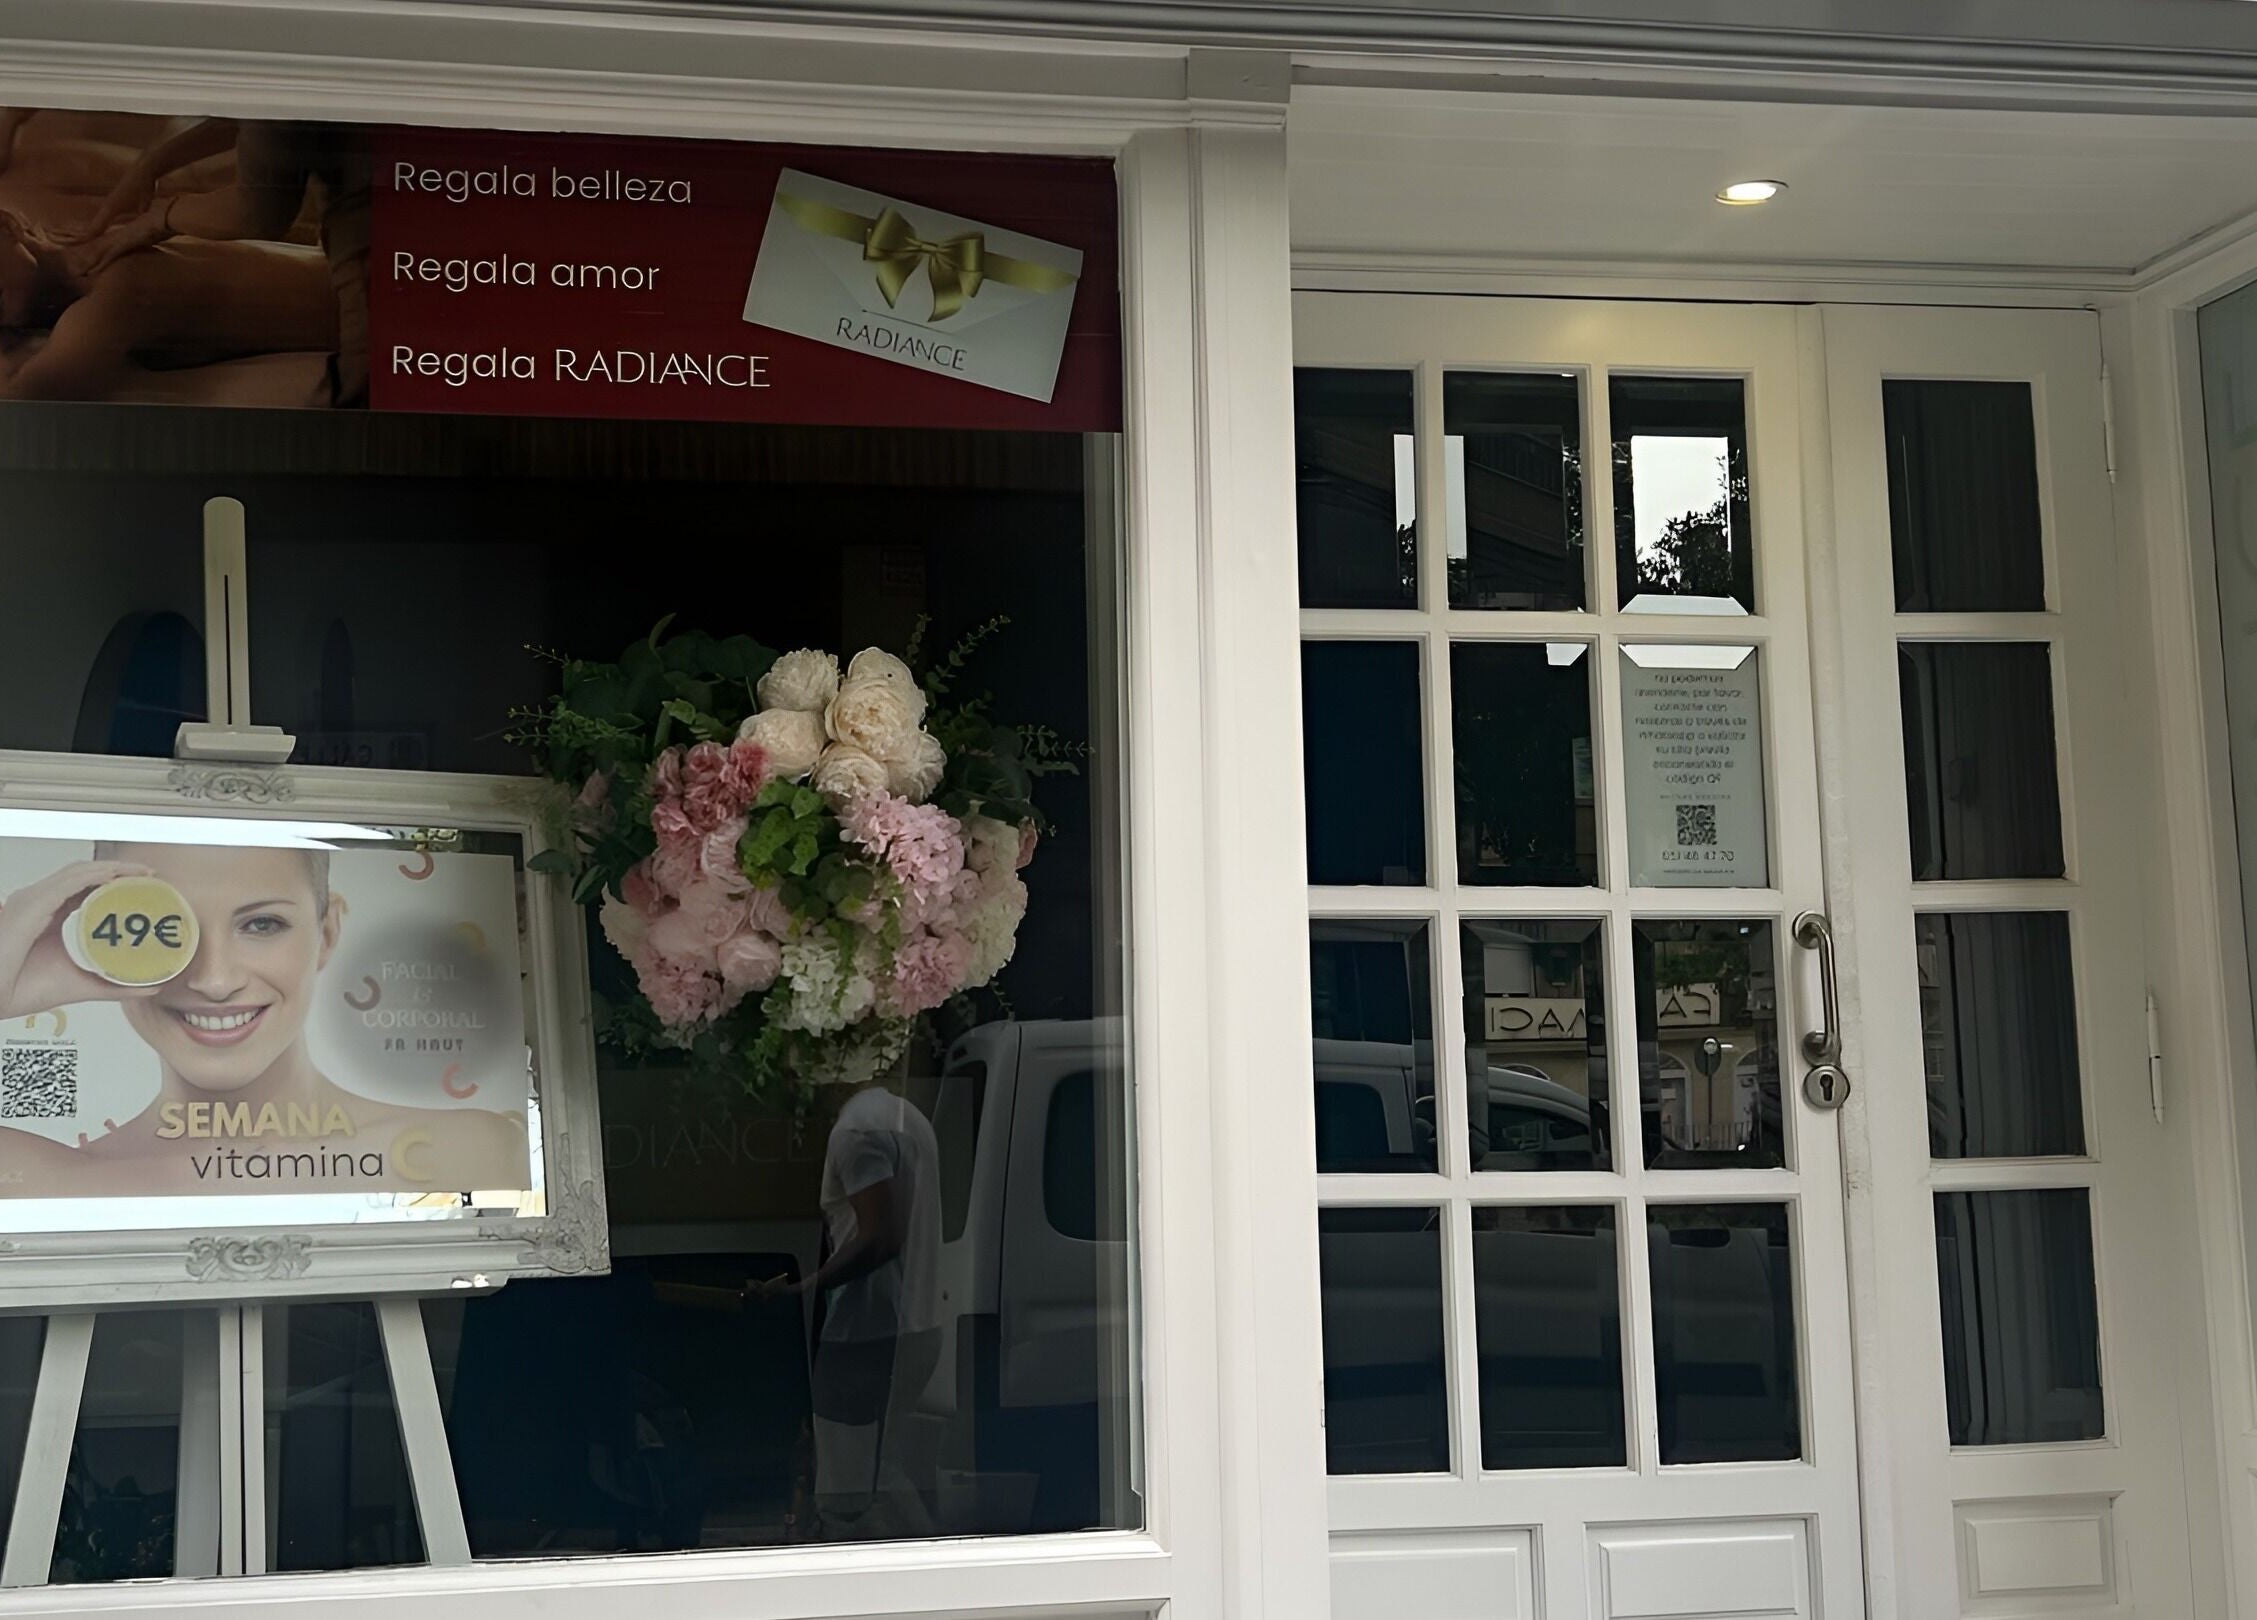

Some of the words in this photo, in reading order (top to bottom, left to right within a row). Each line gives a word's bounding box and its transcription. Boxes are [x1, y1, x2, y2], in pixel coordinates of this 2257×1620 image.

[395, 162, 536, 204] Regala
[553, 167, 693, 205] belleza
[394, 251, 536, 293] Regala
[552, 264, 661, 291] amor
[836, 316, 968, 372] RADIANCE
[393, 345, 536, 388] Regala
[556, 349, 771, 389] RADIANCE
[92, 912, 183, 950] 49€
[156, 1101, 355, 1139] SEMANA
[190, 1145, 384, 1180] vitamina
